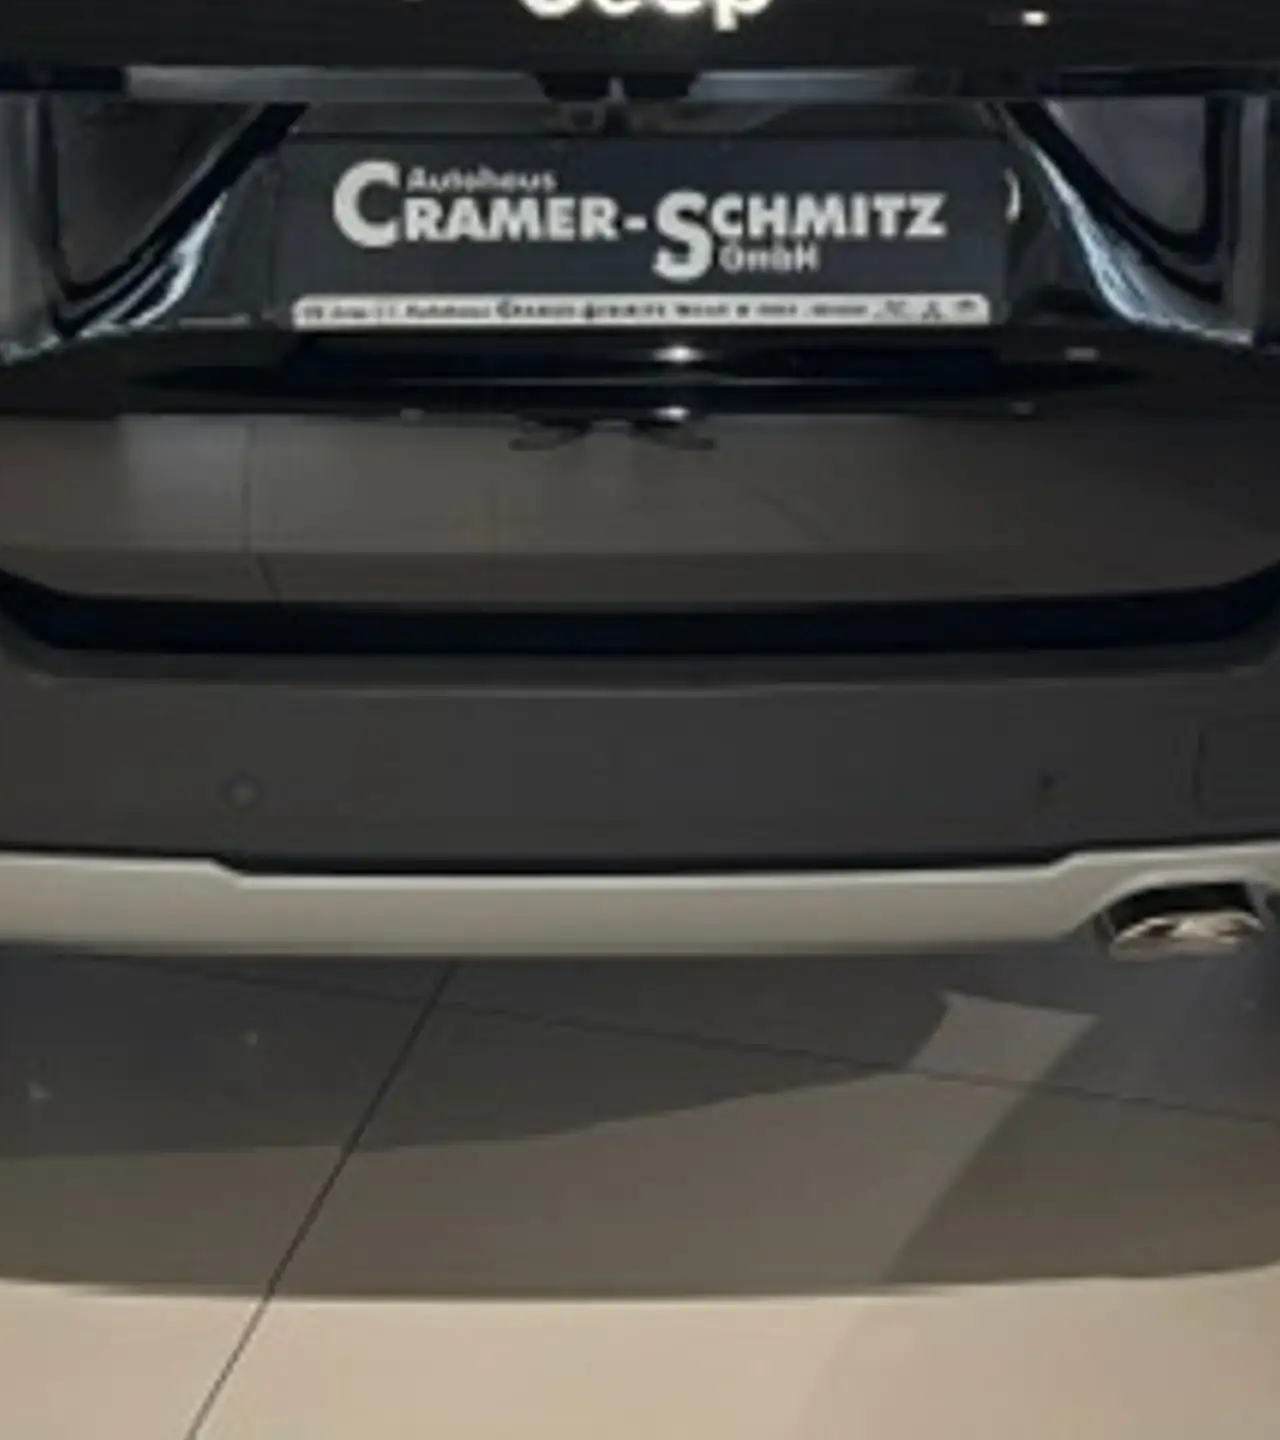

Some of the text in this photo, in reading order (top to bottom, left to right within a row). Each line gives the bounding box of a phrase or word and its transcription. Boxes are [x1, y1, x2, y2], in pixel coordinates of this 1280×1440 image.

[406, 165, 558, 194] Autohaus
[332, 160, 948, 282] CRAMER-SCHMITZ
[718, 243, 821, 274] GmbH
